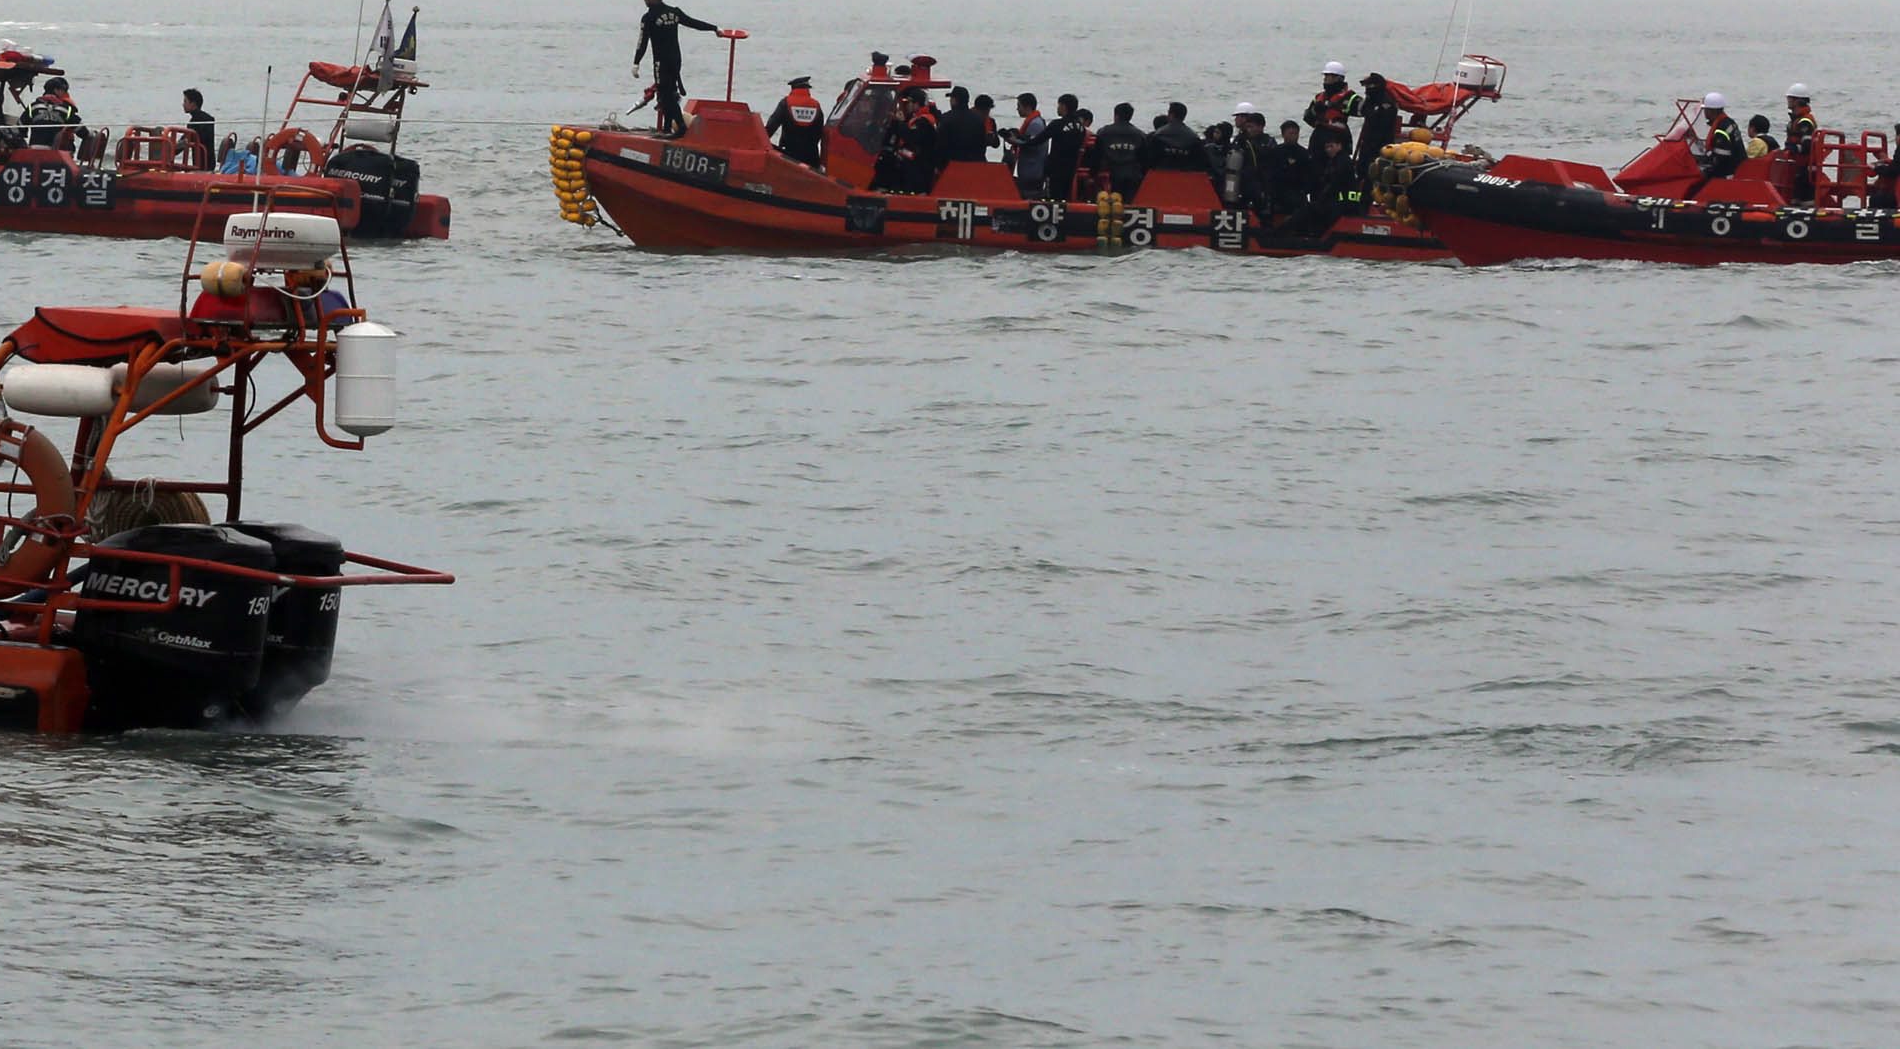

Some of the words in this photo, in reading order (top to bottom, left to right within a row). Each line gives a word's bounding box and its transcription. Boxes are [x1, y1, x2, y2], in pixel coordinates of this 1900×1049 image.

[665, 148, 727, 175] 1508-1
[1473, 172, 1522, 189] 3009-2
[230, 225, 295, 239] Raymarine
[85, 571, 217, 608] MERCURY
[248, 596, 270, 615] 150
[319, 592, 340, 612] 150
